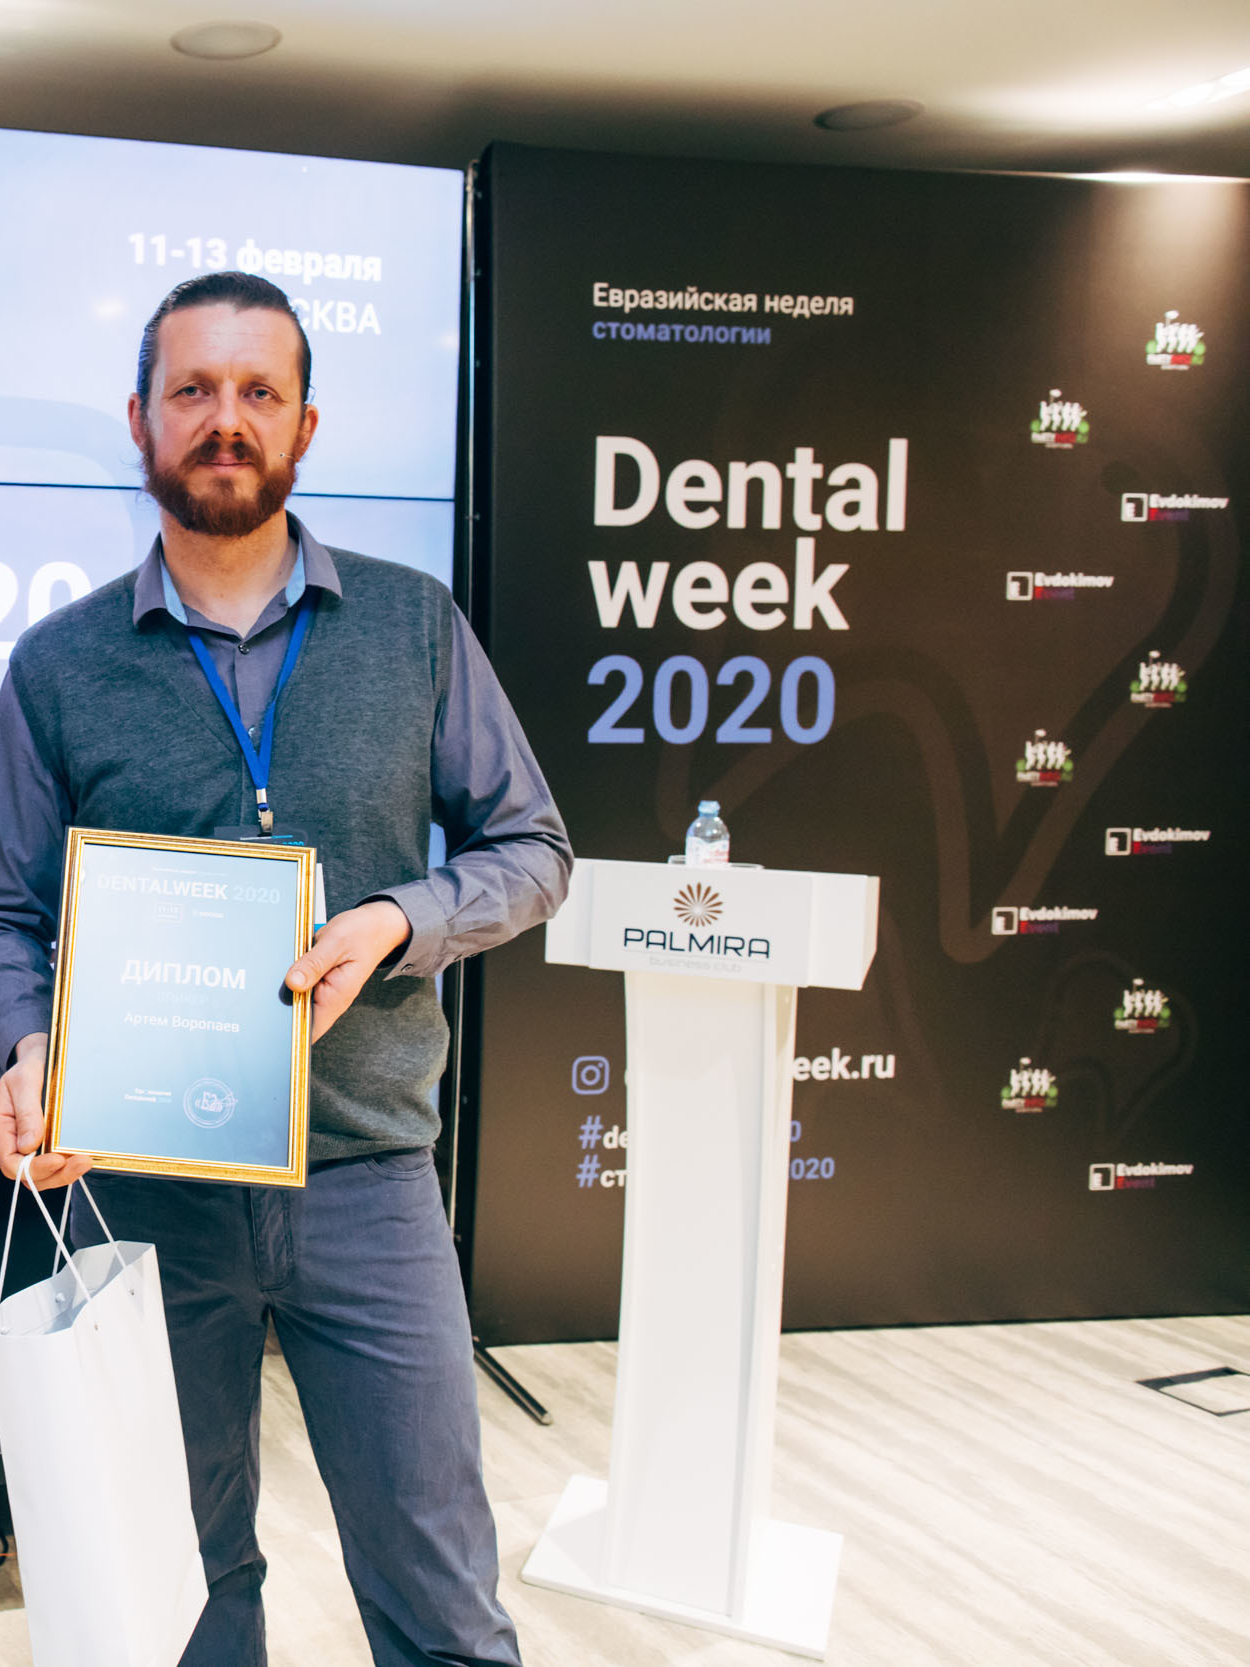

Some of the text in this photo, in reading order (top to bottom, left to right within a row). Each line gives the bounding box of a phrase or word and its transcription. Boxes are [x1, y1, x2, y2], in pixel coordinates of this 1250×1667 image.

[128, 232, 383, 286] 11-13 февраля
[592, 281, 855, 319] Евразийская неделя
[591, 320, 772, 345] стоматологии
[593, 435, 909, 532] Dental
[1149, 493, 1230, 509] Evdokimov
[587, 537, 850, 631] week
[1034, 572, 1115, 588] Evdokimov
[587, 654, 836, 745] 2020
[1133, 827, 1211, 842] Evdokimov
[96, 873, 281, 905] DENTALWEEK 2020
[1019, 905, 1099, 921] Evdokimov
[623, 928, 770, 959] PALMIRA
[120, 959, 247, 990] ДИПЛОМ
[124, 1011, 240, 1033] Артем Воропаев
[1116, 1161, 1194, 1177] Evdokimov
